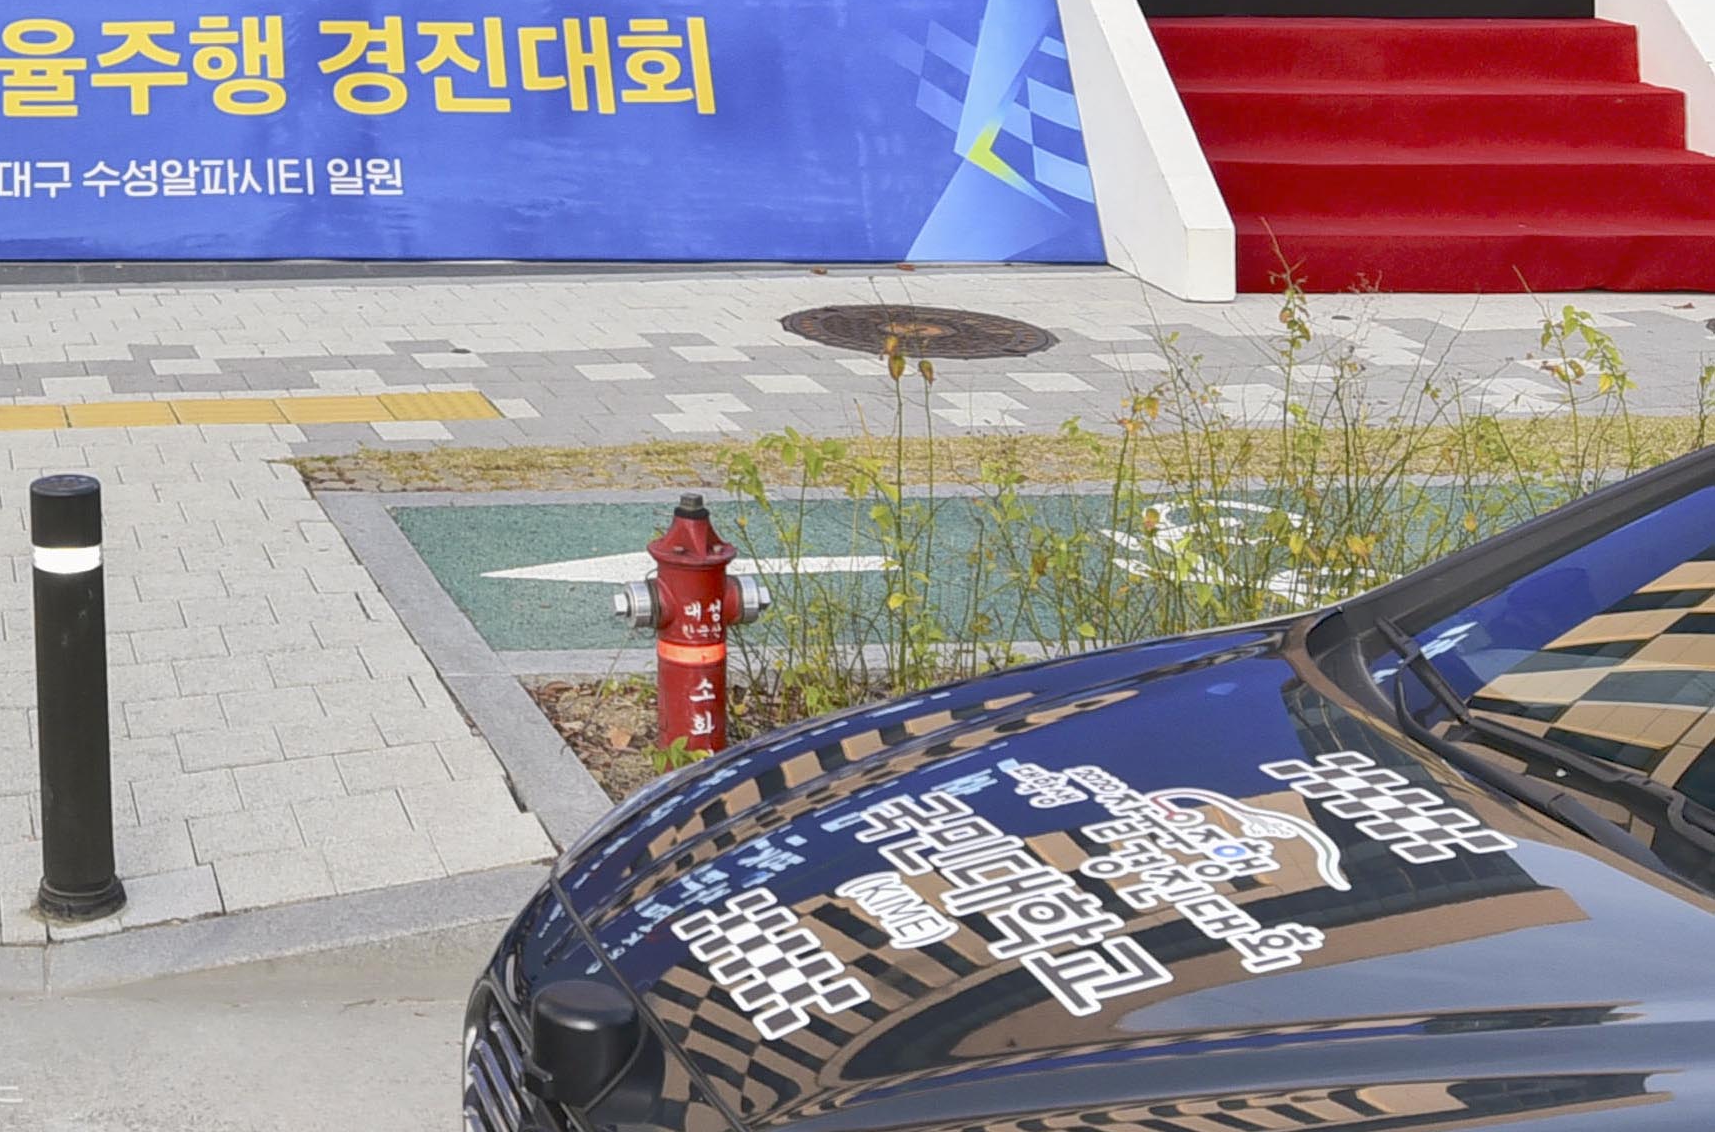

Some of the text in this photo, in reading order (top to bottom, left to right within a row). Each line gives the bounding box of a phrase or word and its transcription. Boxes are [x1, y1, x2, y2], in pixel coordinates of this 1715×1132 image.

[316, 16, 718, 116] 경진대회
[81, 159, 316, 200] 수성알파시티
[326, 159, 404, 198] 일원
[1014, 765, 1325, 974] 대학생 경진대회
[1072, 767, 1281, 879] 2020 자율주행
[836, 872, 959, 949] (KIME)
[854, 791, 1173, 1016] 국민대학교
